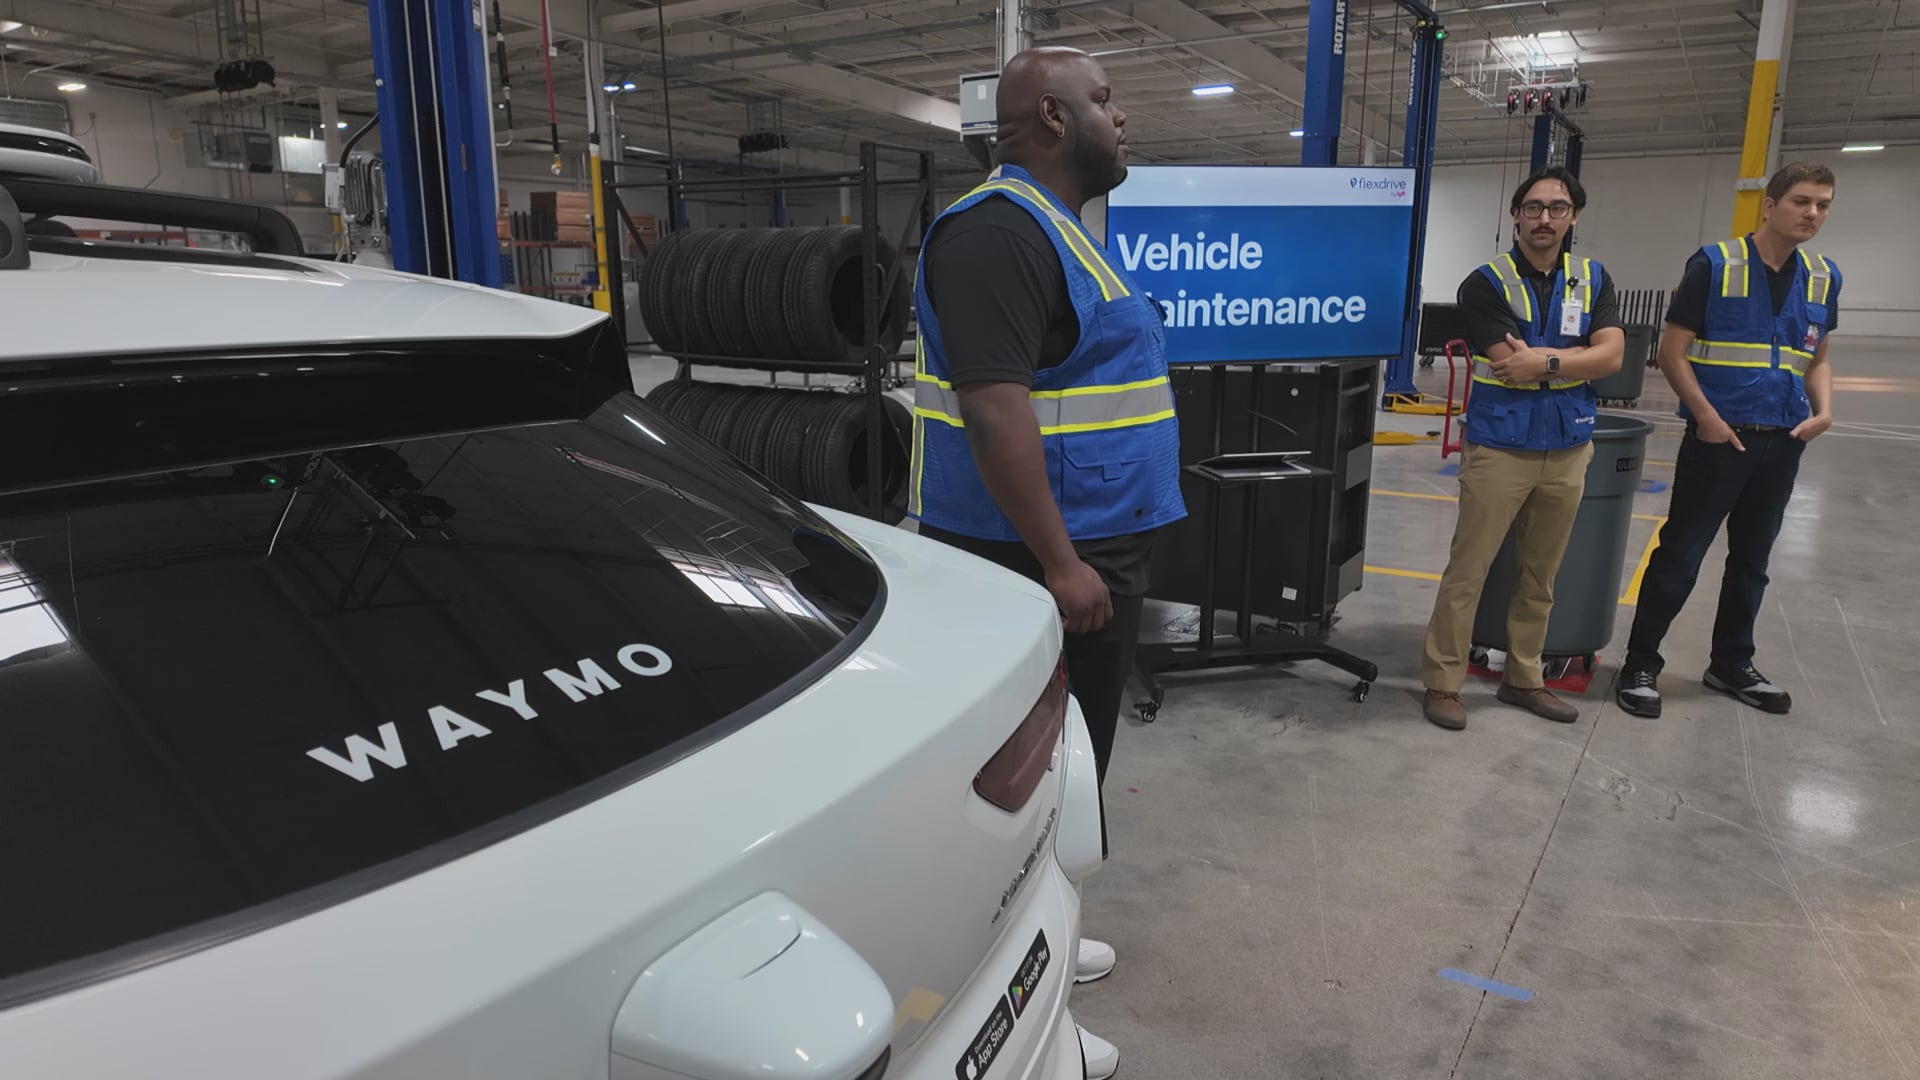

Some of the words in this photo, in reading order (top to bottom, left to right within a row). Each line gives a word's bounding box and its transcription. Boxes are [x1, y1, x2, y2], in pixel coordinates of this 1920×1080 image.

[1333, 0, 1346, 55] ROTAR
[1359, 177, 1407, 189] flexdrive
[1117, 231, 1263, 271] Vehicle
[1148, 289, 1367, 328] aintenance
[306, 643, 673, 783] WAYMO
[1023, 960, 1041, 991] Google
[1037, 946, 1048, 967] Play
[975, 1025, 992, 1053] Download
[977, 1043, 993, 1069] App
[990, 1018, 1008, 1047] Store
